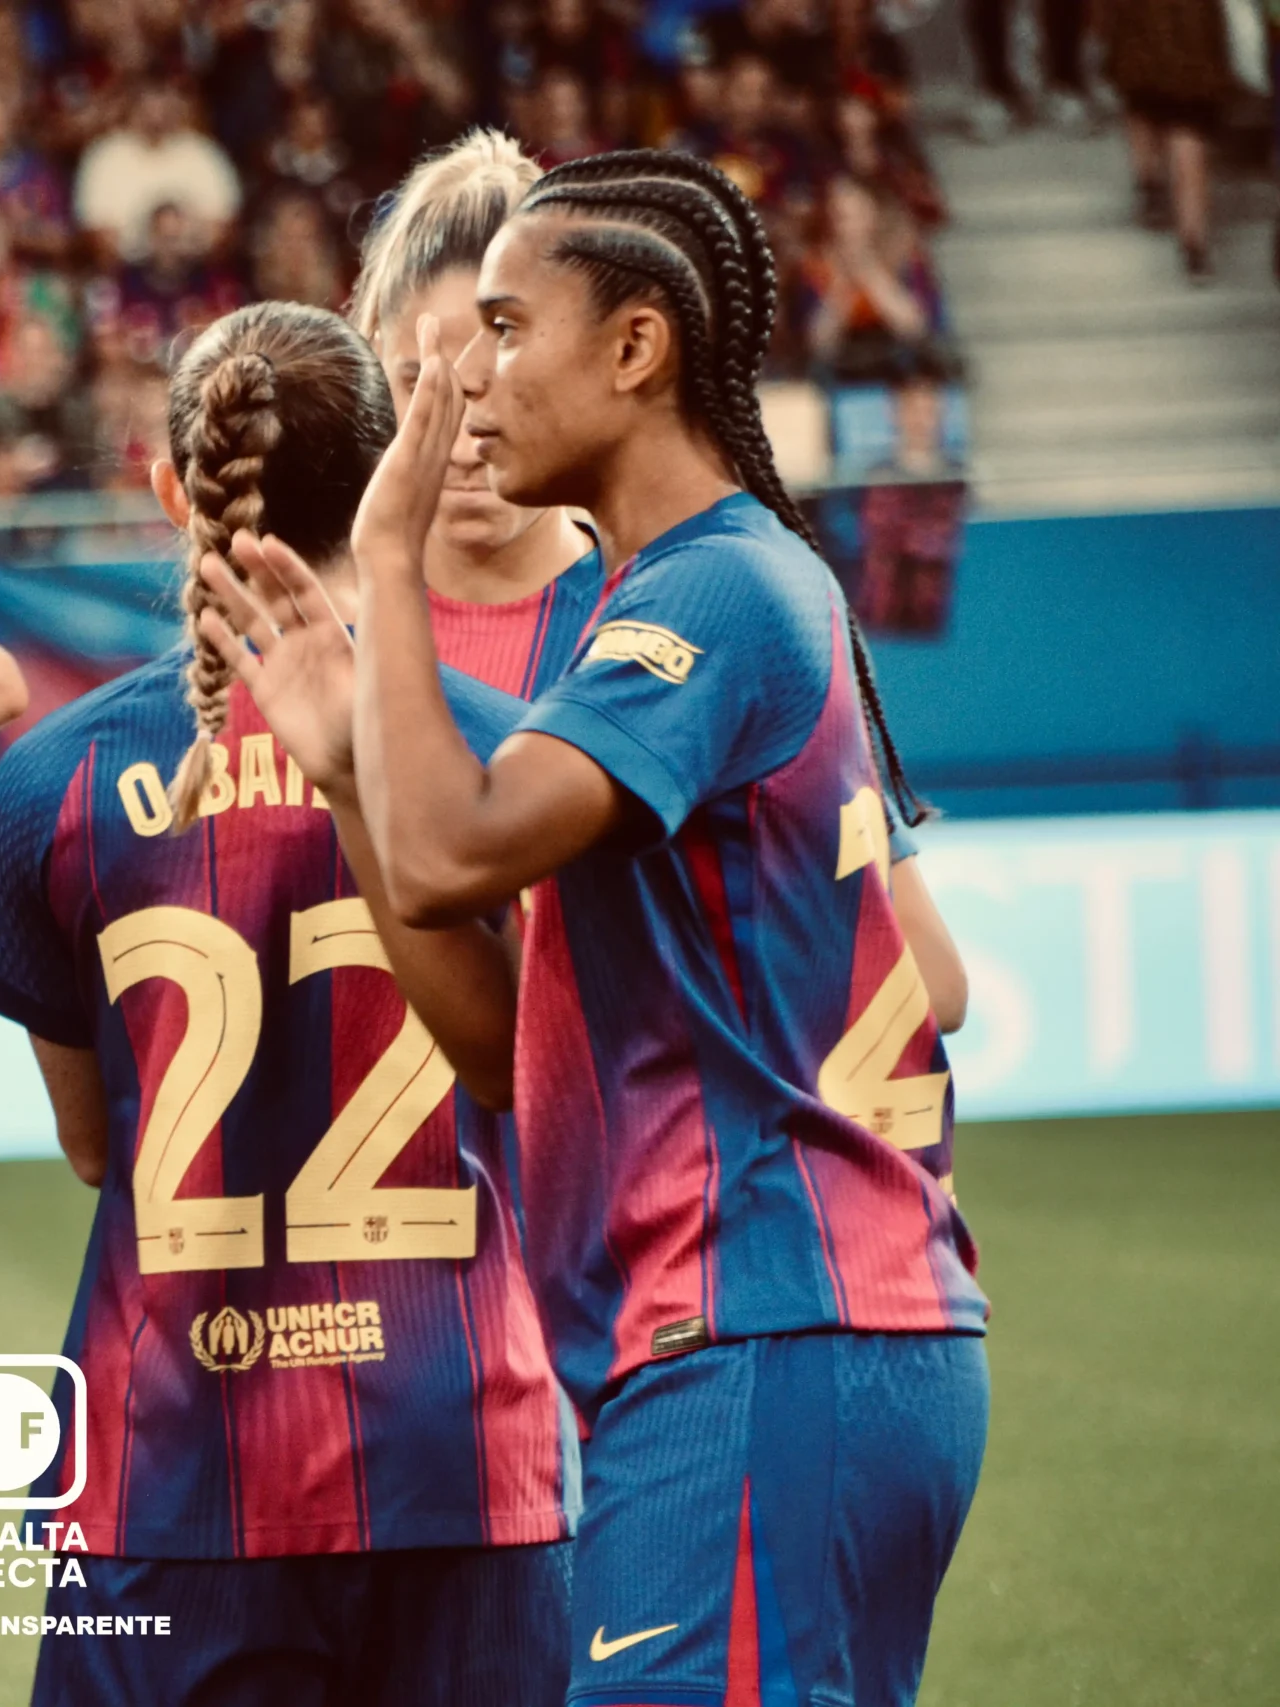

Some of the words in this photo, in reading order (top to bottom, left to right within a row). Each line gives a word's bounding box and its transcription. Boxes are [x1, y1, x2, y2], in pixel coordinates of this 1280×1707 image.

[97, 897, 477, 1275] 22
[267, 1301, 381, 1333] UNHCR
[269, 1327, 384, 1358] ACNUR
